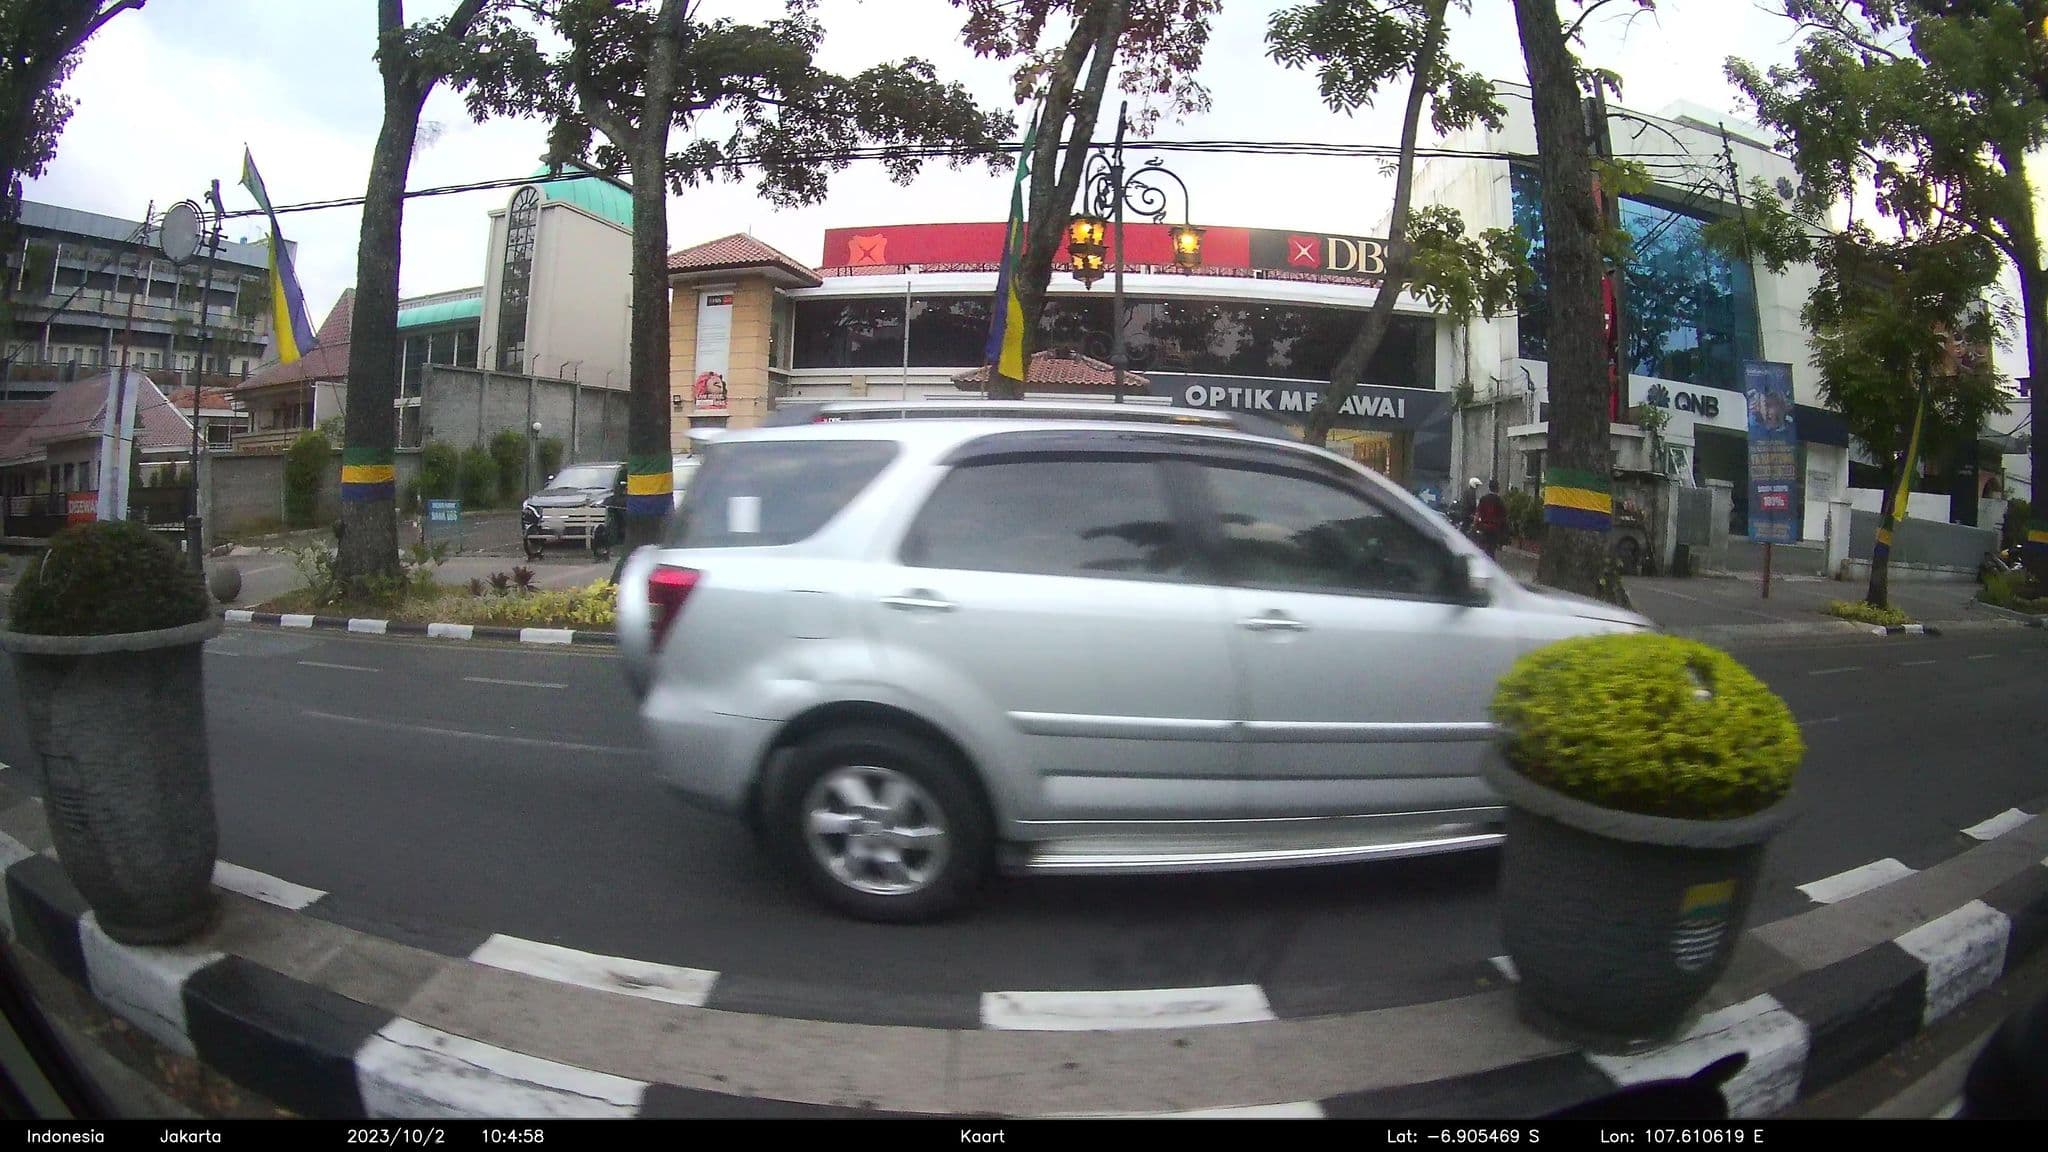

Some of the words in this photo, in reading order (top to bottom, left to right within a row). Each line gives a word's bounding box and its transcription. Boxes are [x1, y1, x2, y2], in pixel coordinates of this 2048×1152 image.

[1185, 384, 1274, 410] OPTIK
[1278, 390, 1405, 419] MEAWAI
[1674, 391, 1720, 418] QNB
